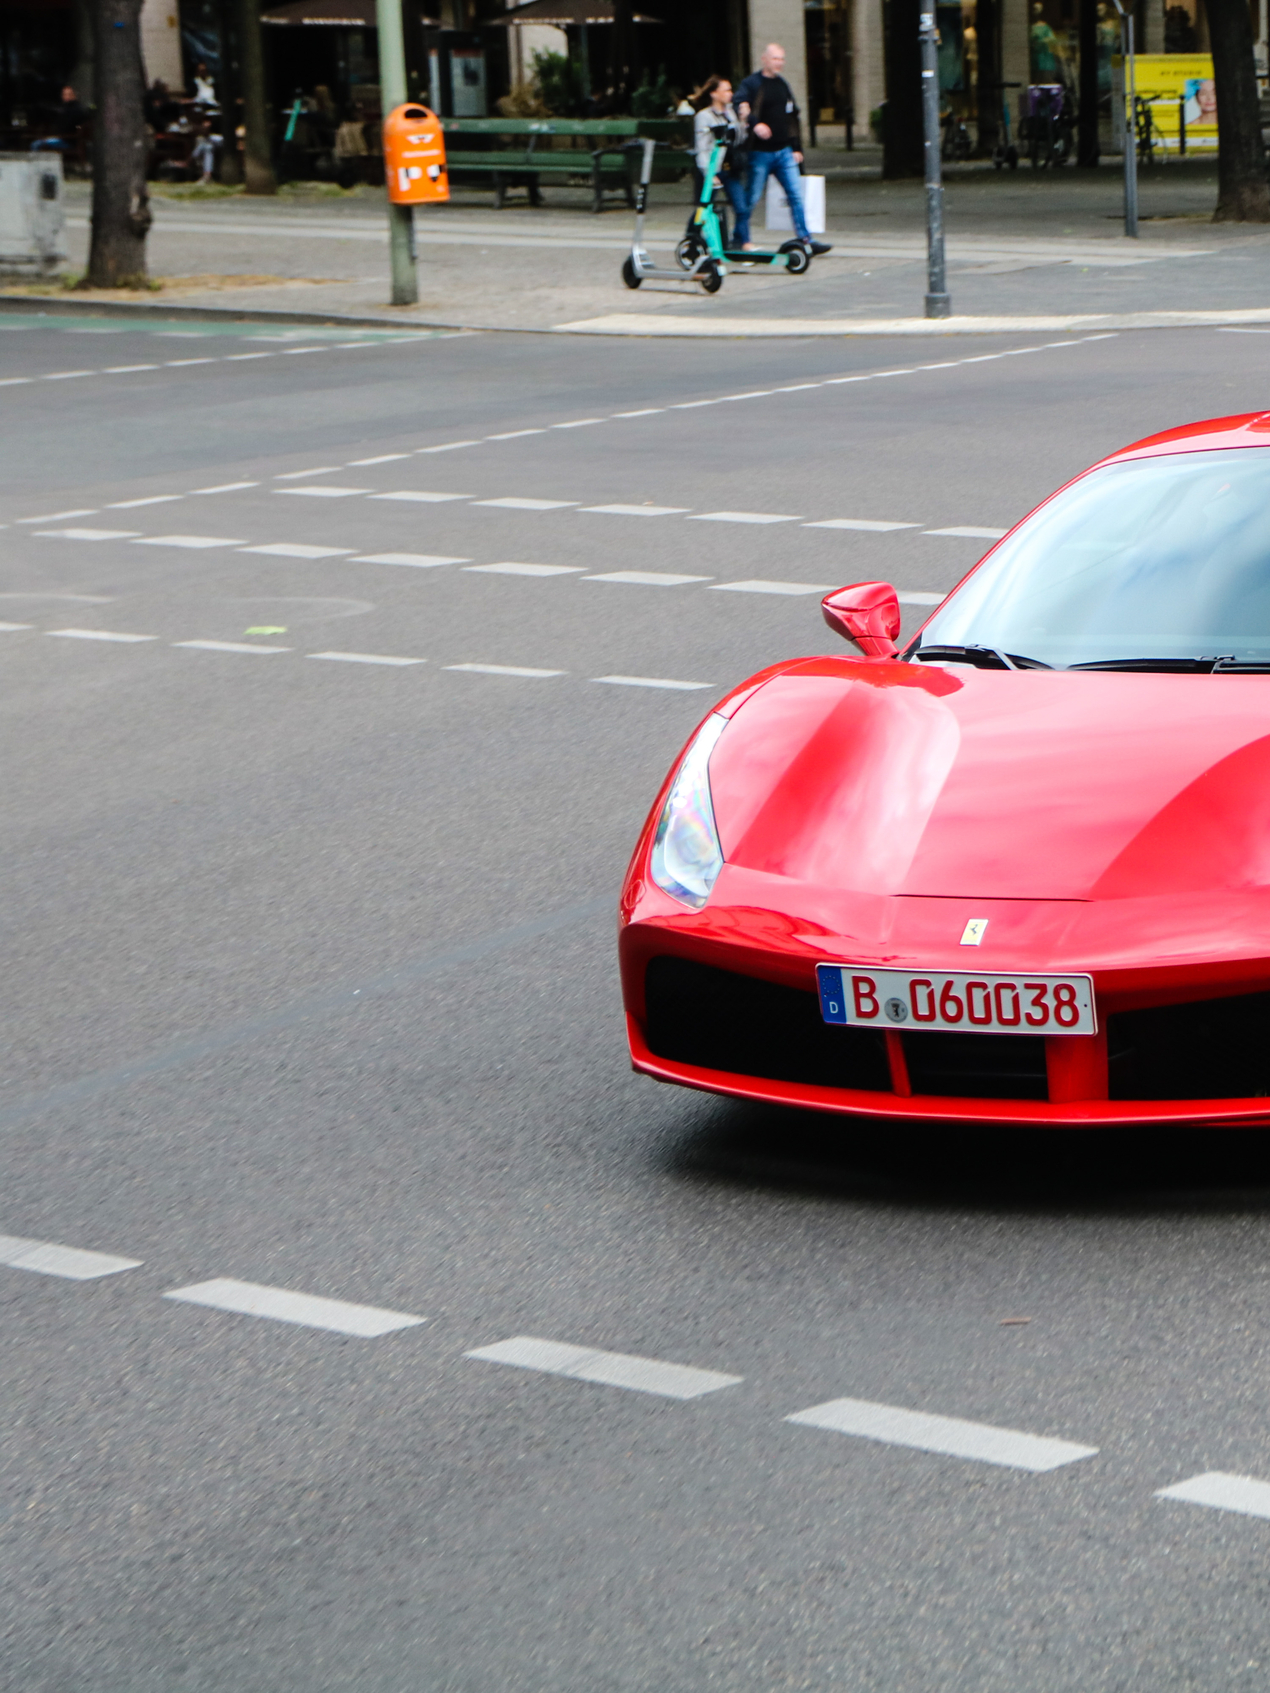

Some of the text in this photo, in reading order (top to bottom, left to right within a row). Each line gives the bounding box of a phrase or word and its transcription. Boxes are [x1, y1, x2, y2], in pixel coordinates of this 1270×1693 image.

[829, 1001, 839, 1014] D
[852, 974, 1080, 1027] B 060038
